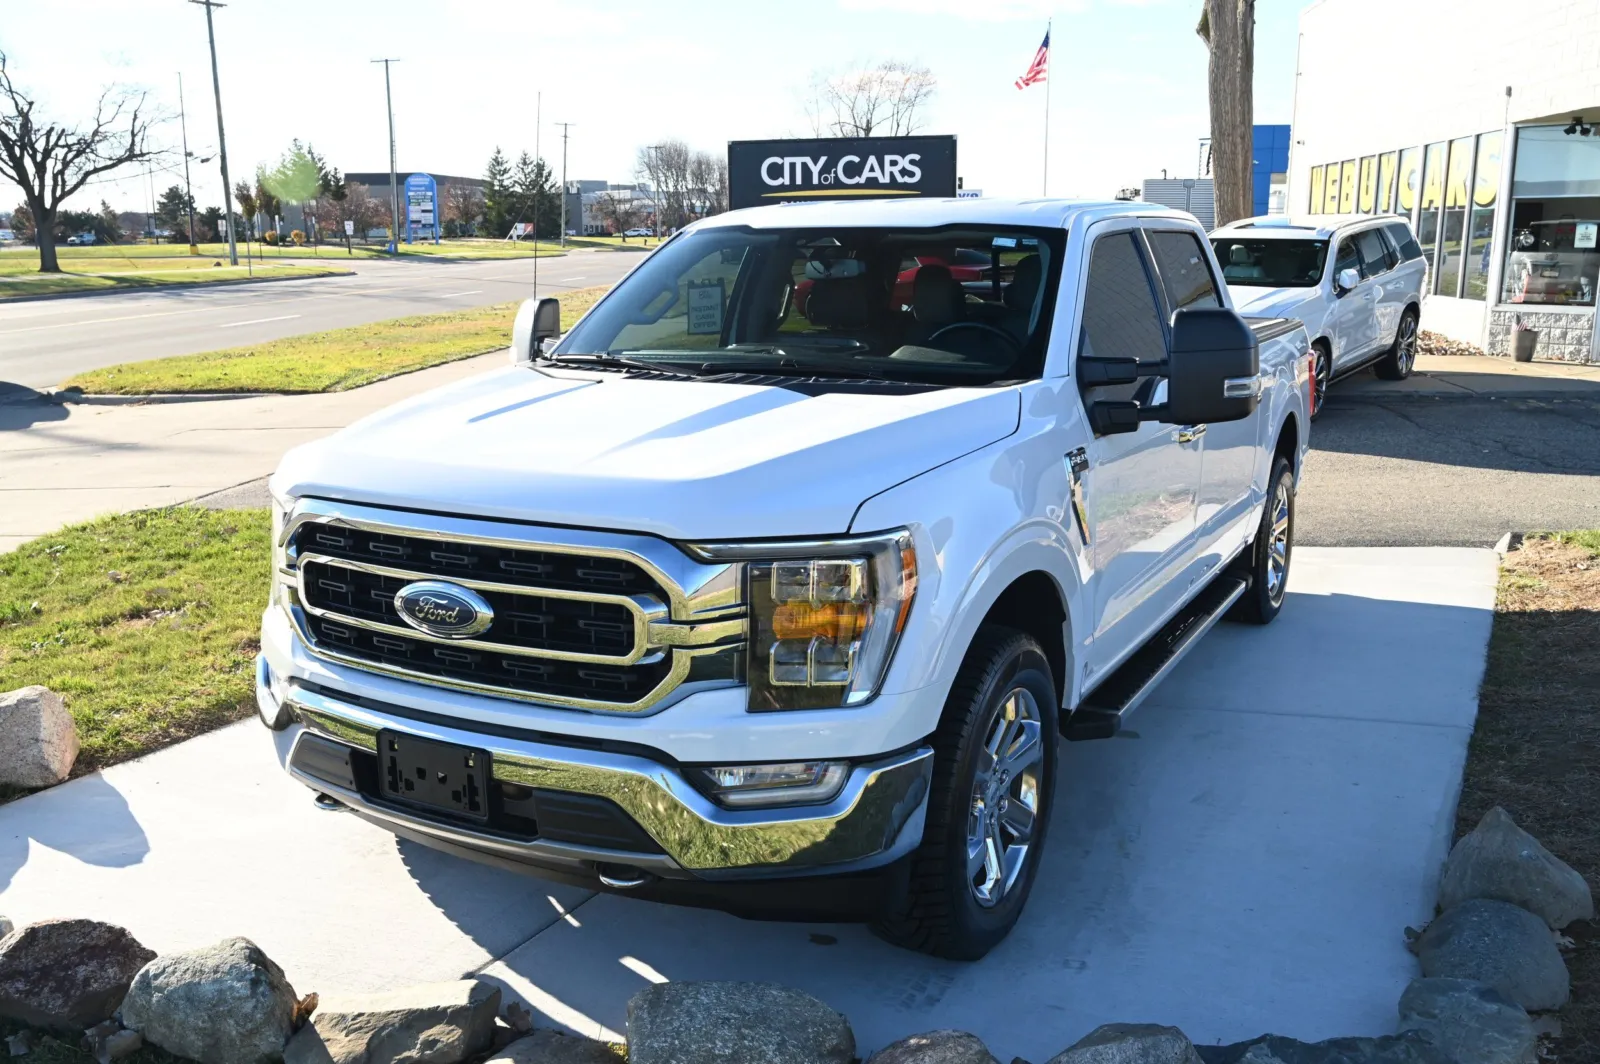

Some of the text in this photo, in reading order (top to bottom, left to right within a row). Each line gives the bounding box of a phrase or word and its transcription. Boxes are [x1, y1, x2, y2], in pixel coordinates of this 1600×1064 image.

[760, 153, 922, 186] CITY of CARS
[1340, 155, 1396, 213] BUY
[1399, 134, 1502, 208] CARS
[694, 321, 717, 329] OFFER
[695, 312, 715, 320] CASH
[415, 595, 460, 623] Ford
